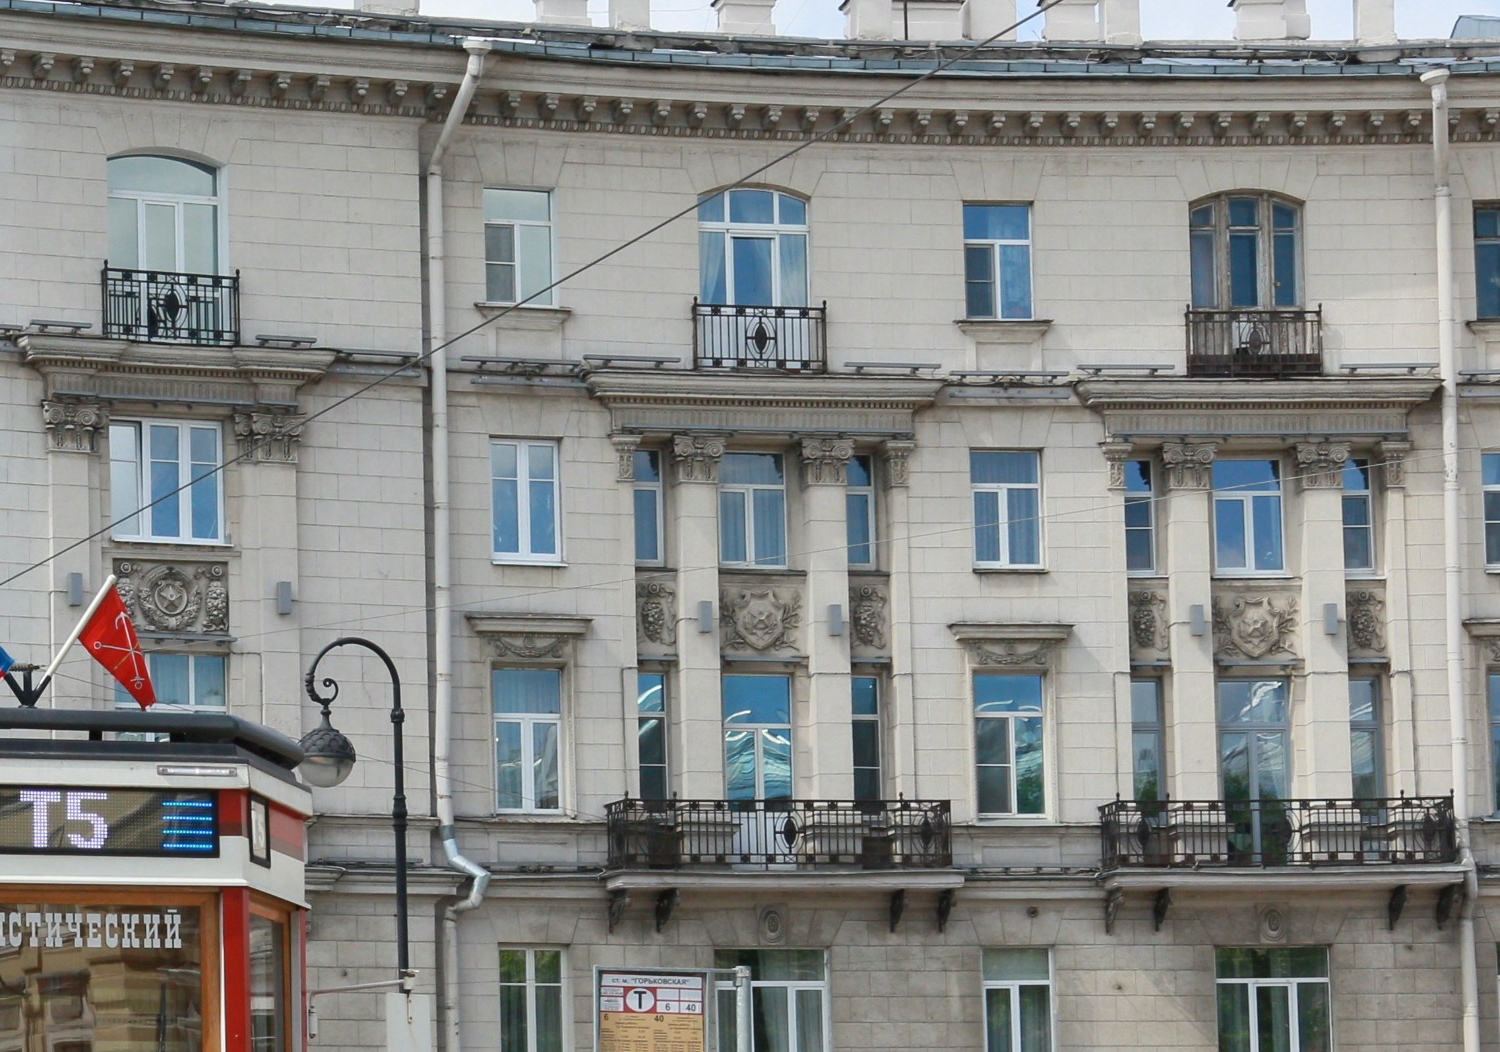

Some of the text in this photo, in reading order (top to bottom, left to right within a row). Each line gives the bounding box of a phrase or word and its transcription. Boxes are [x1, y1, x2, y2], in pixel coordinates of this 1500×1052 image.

[20, 790, 108, 849] Т5
[633, 990, 647, 1009] Т
[665, 1003, 696, 1012] 6 40
[603, 1013, 609, 1021] 6
